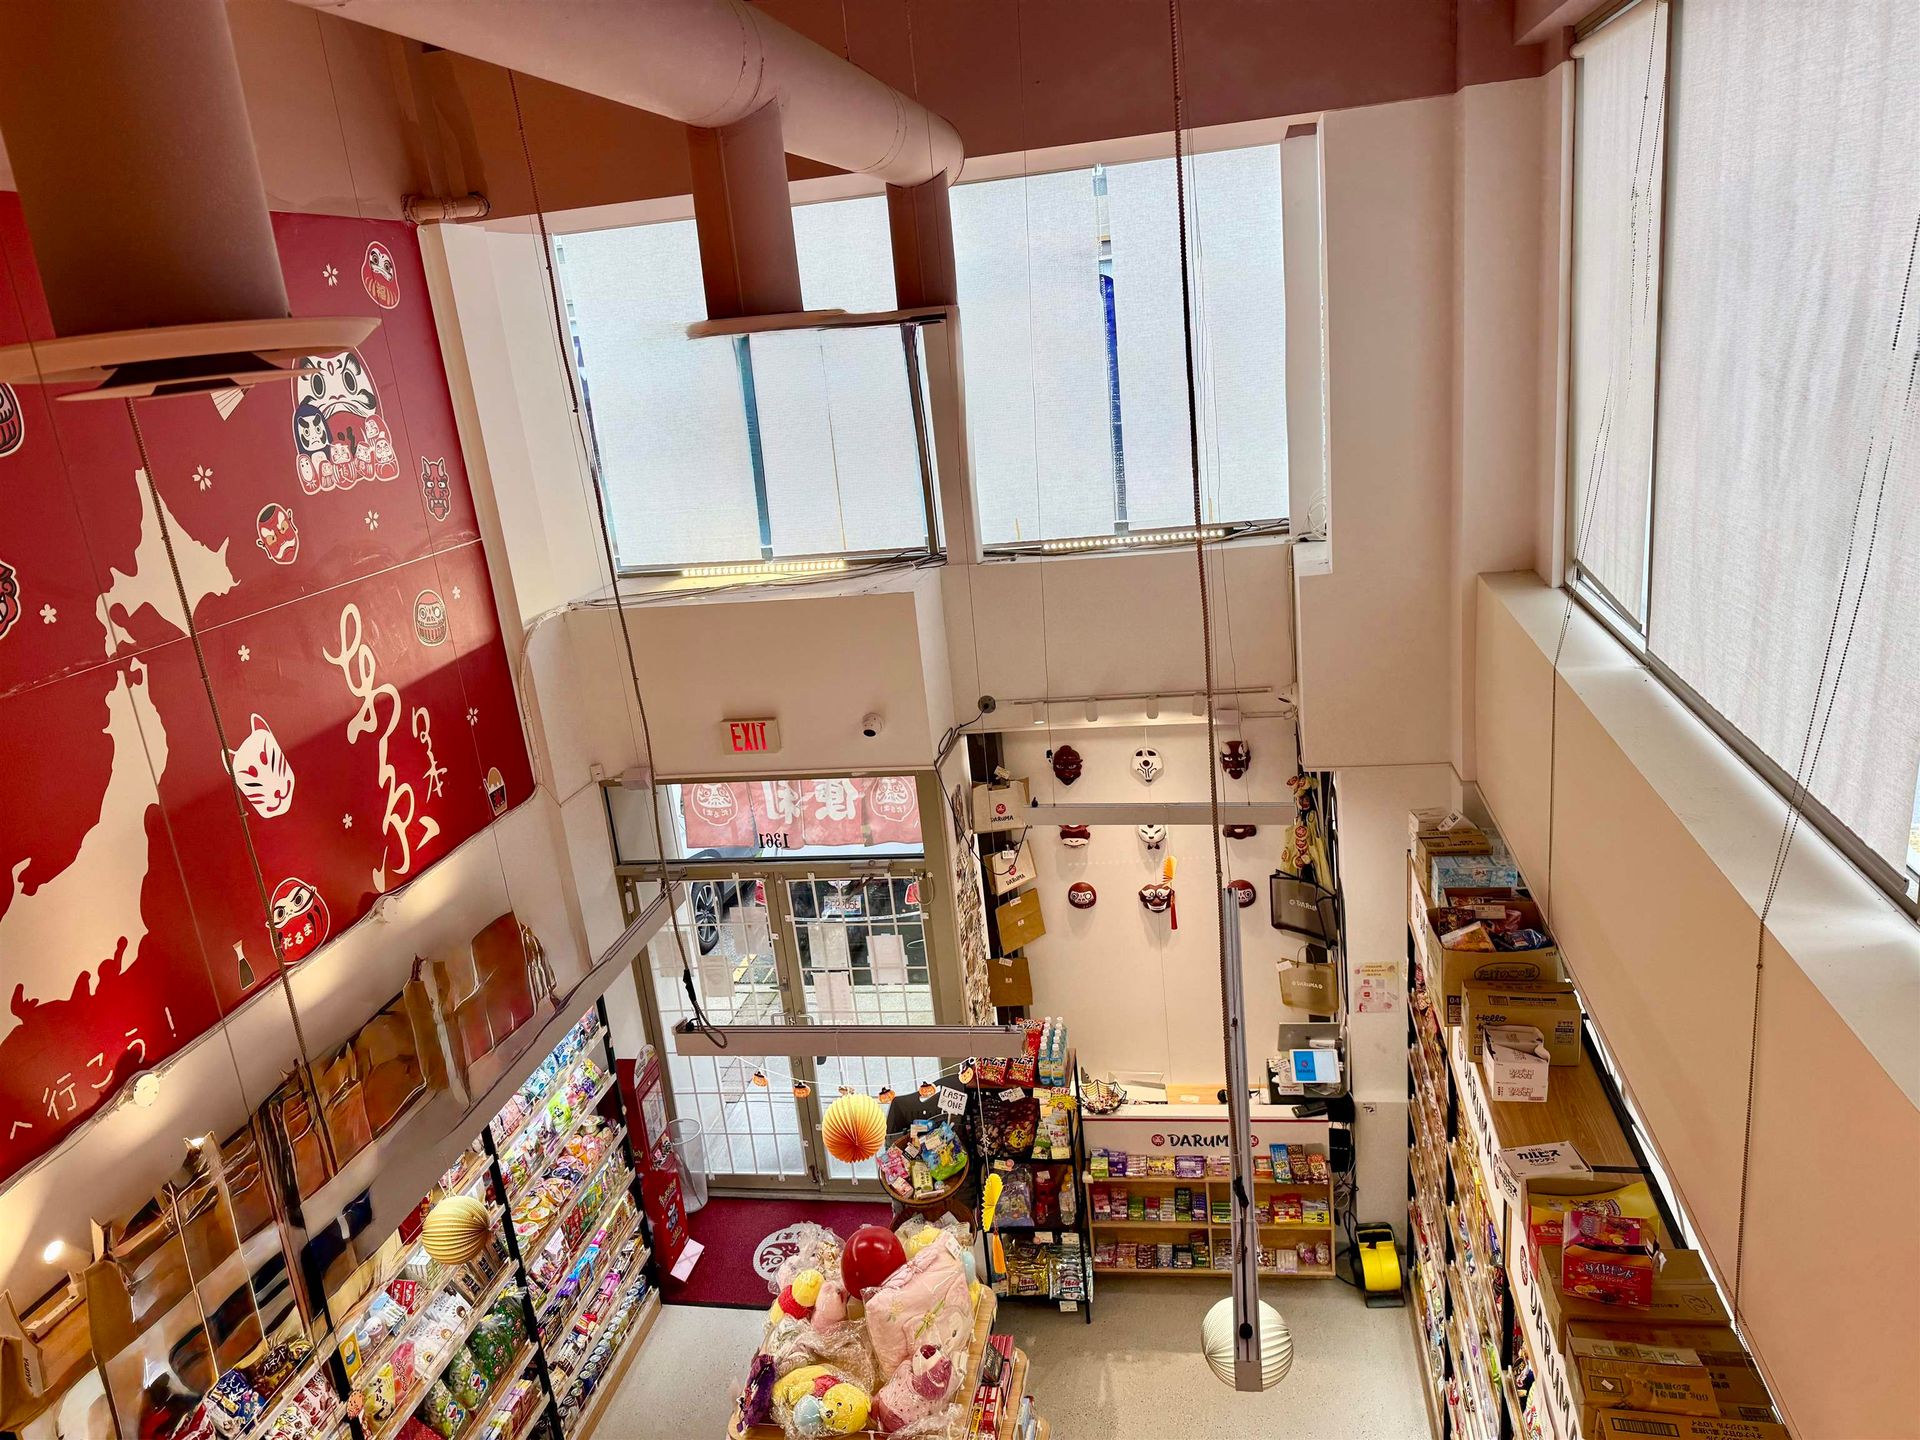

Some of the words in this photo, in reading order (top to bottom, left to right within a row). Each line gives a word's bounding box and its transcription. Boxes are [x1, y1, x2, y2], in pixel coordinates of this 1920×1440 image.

[730, 722, 768, 751] EXIT
[283, 922, 313, 950] だるま
[1474, 1013, 1507, 1023] Hello
[942, 1088, 966, 1101] LAST
[947, 1101, 963, 1111] ONE
[1167, 1134, 1229, 1147] DARUM
[1517, 1149, 1561, 1161] カルピス
